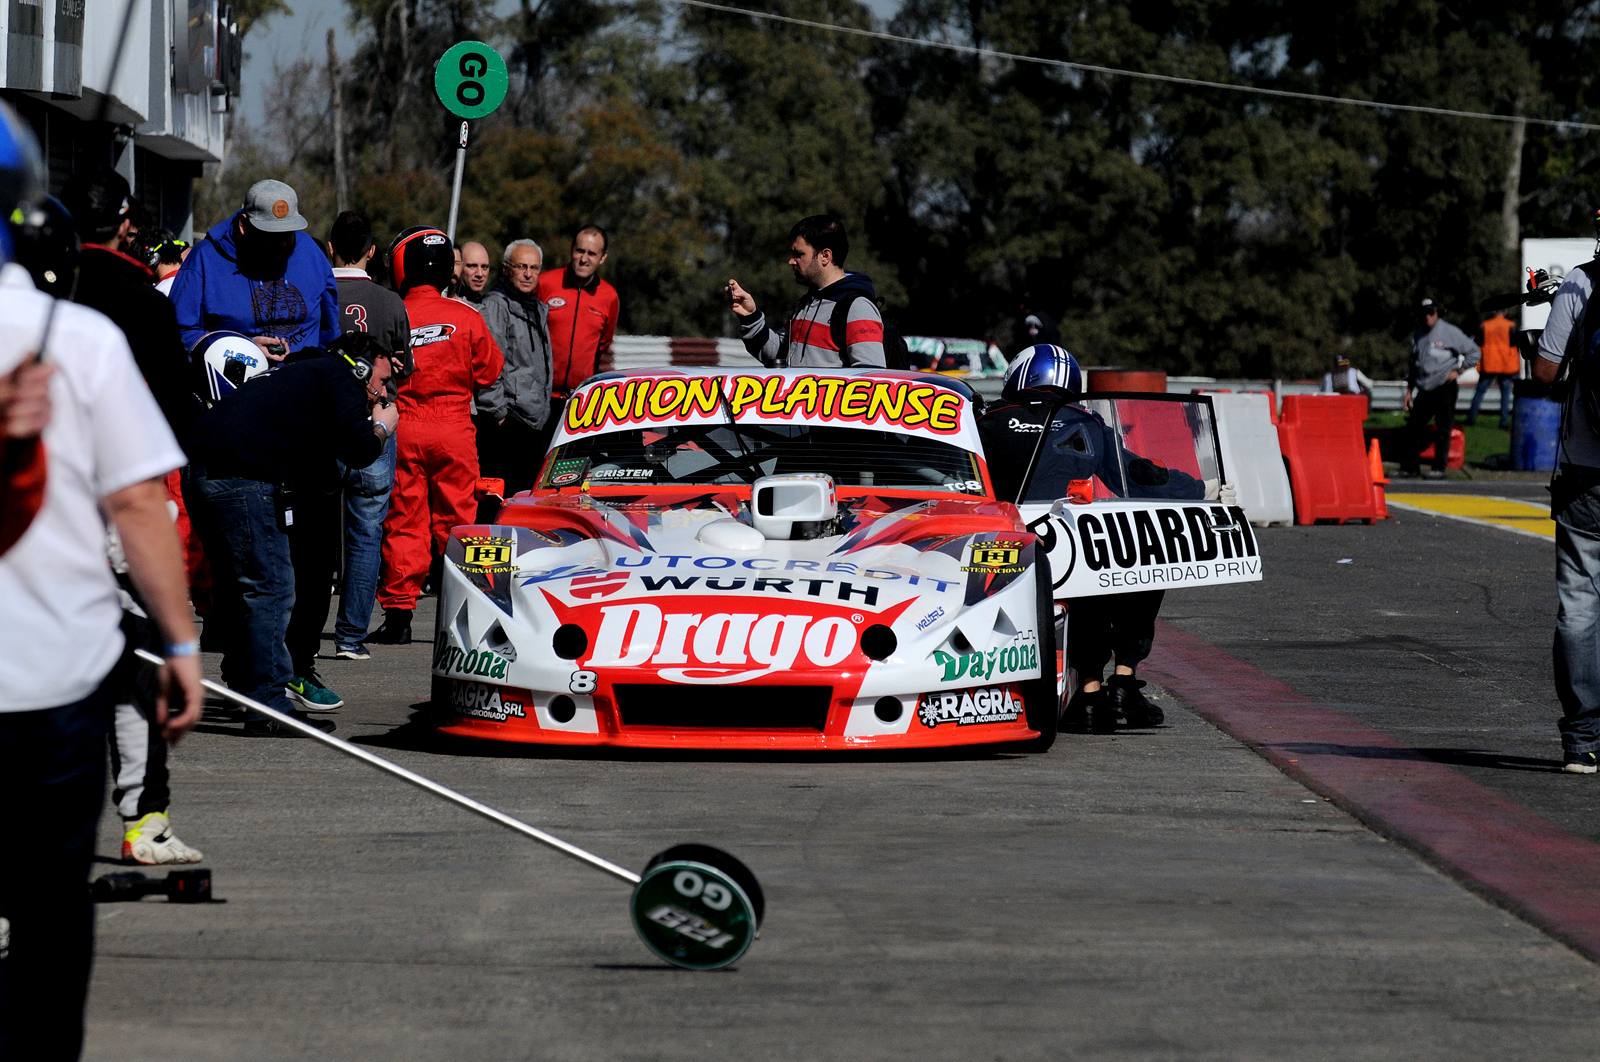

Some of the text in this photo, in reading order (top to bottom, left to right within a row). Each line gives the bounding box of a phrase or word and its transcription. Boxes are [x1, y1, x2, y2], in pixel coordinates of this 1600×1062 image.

[456, 52, 488, 107] GO
[567, 375, 960, 431] UNION PLATENSE
[594, 469, 654, 478] CRISTEM
[1099, 565, 1209, 588] SEGURIDAD
[932, 643, 1038, 682] Daytona
[569, 670, 598, 694] 8
[503, 702, 526, 717] SRL
[940, 688, 1014, 719] RAGRA
[959, 716, 976, 725] AIRE
[673, 870, 732, 911] GO
